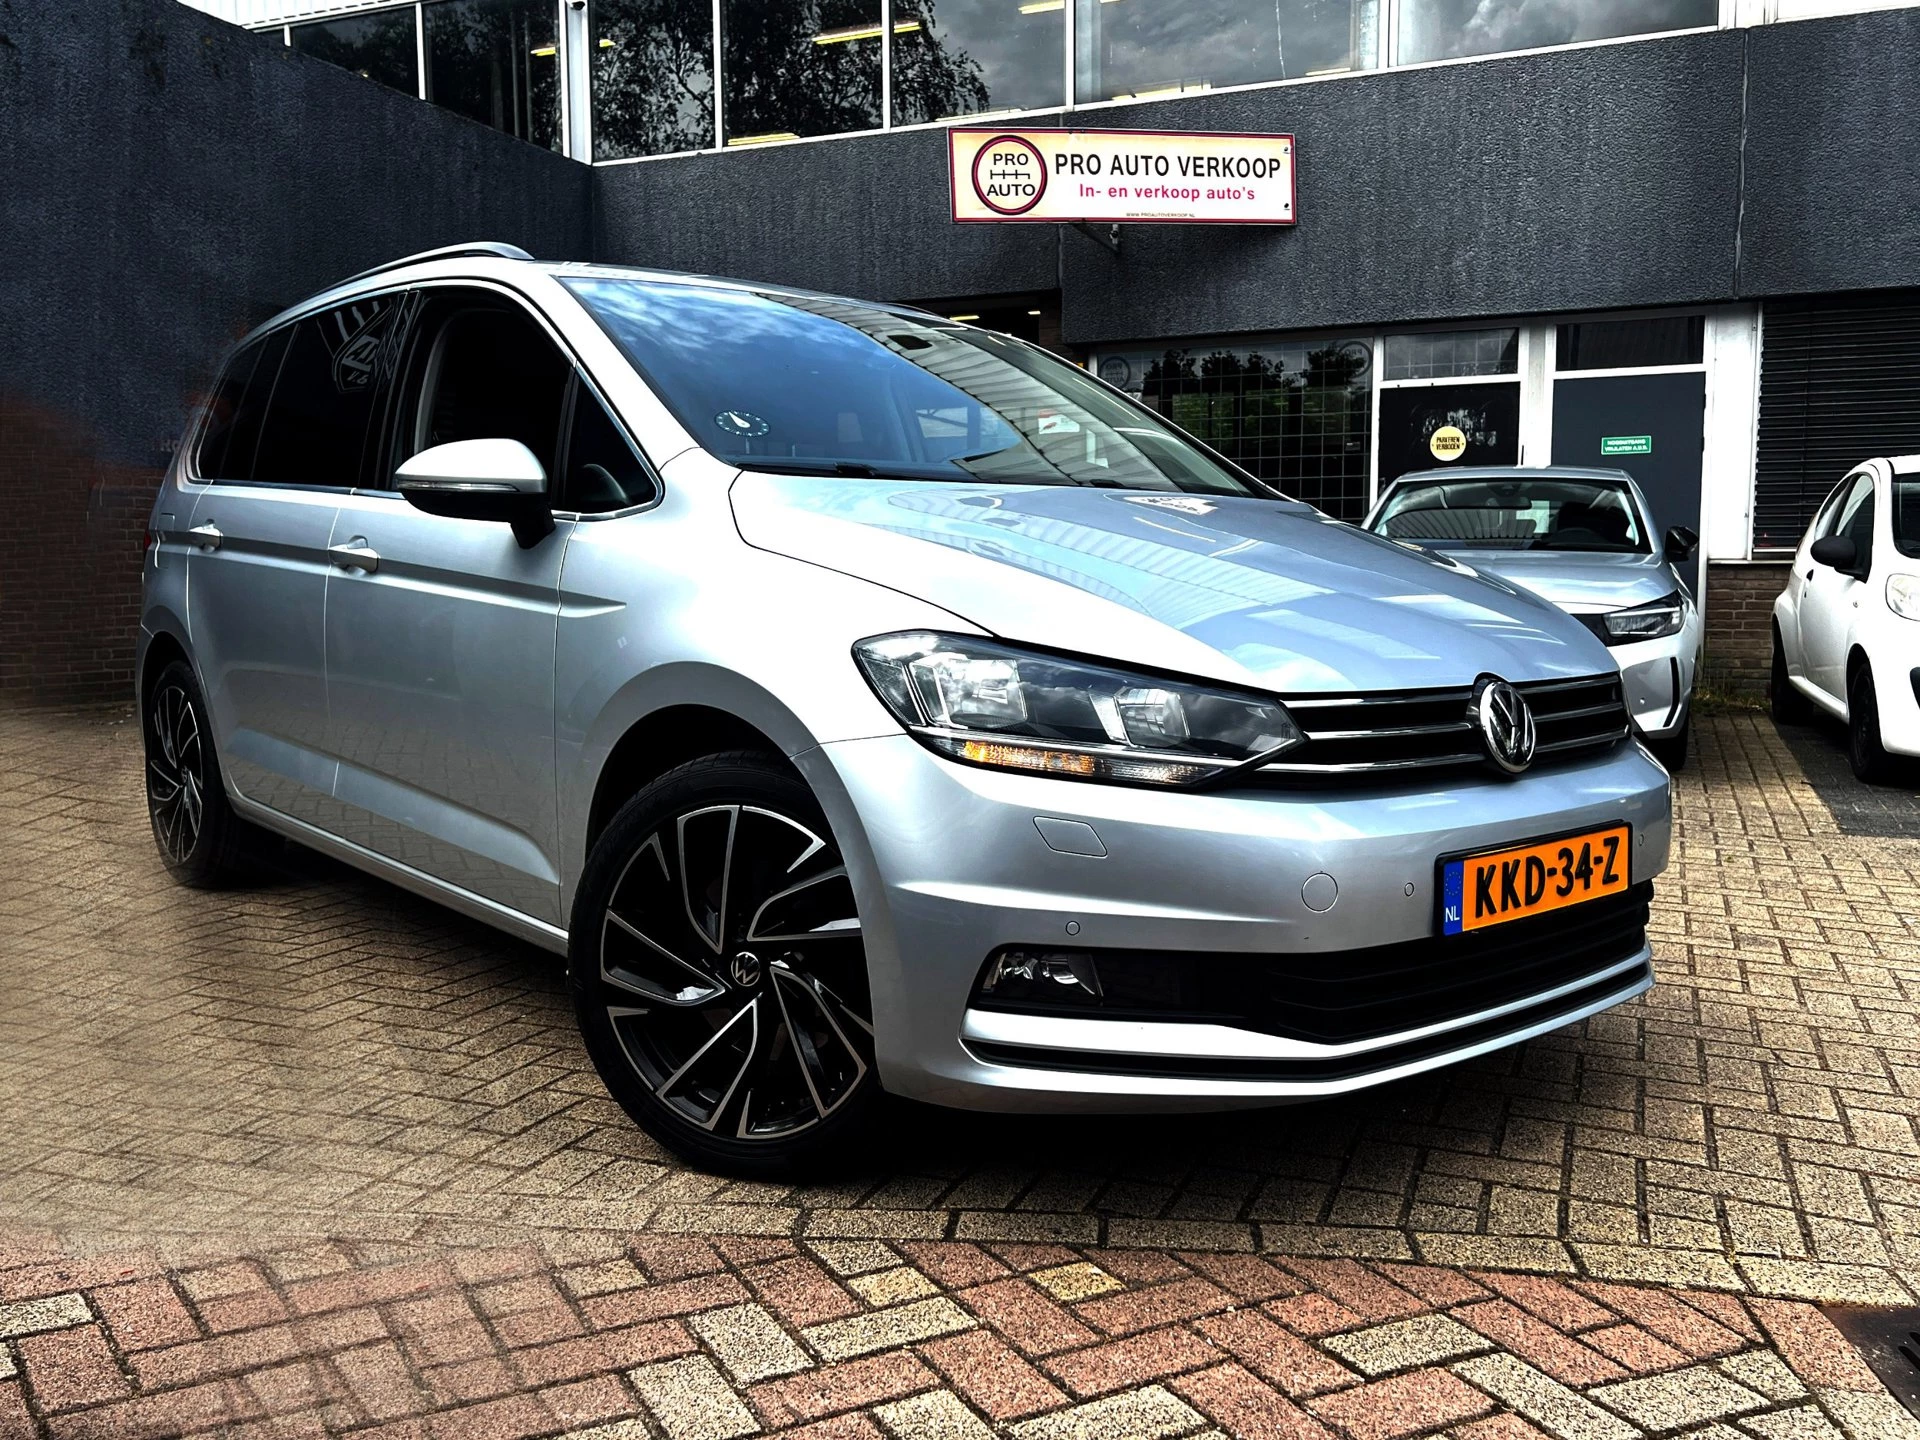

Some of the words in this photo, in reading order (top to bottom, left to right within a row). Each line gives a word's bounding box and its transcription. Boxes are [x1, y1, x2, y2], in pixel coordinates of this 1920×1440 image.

[992, 152, 1029, 167] PRO
[1055, 153, 1101, 176] PRO
[1109, 154, 1169, 177] AUTO
[1177, 156, 1282, 179] VERKOOP
[986, 183, 1036, 197] AUTO
[1079, 183, 1102, 198] In-
[1108, 187, 1128, 198] en
[1134, 185, 1200, 202] verkoop
[1206, 186, 1256, 200] auto's
[1475, 835, 1620, 919] KKD-34-Z
[1444, 905, 1460, 923] NL
